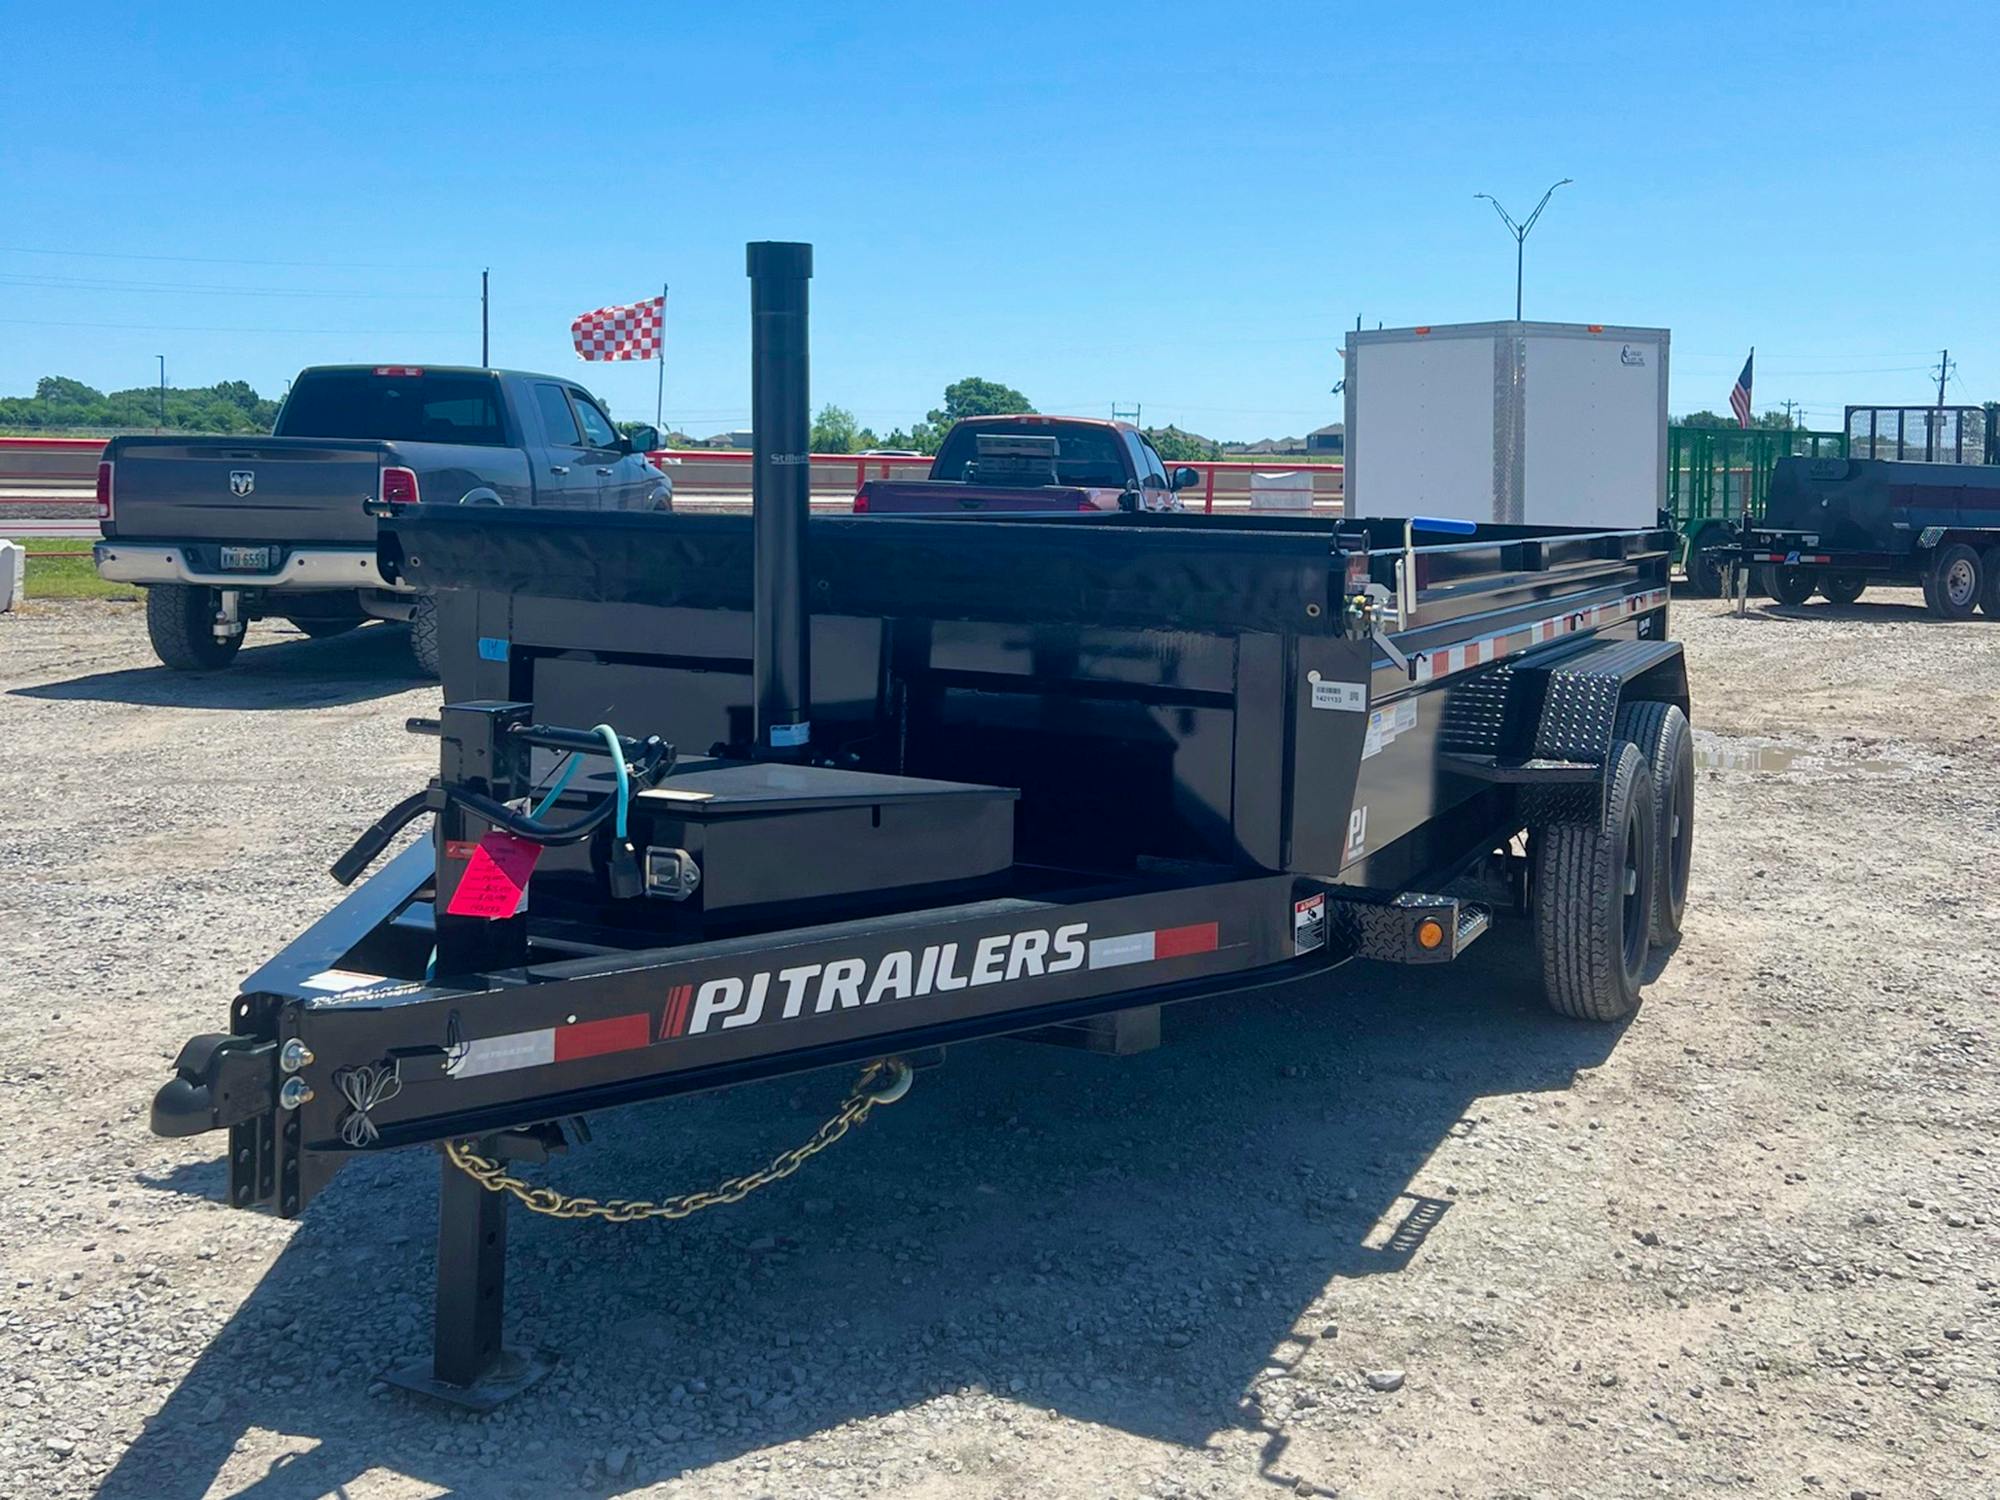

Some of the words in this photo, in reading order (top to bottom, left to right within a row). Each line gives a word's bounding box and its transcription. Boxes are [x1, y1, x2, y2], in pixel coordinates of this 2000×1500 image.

[1348, 806, 1367, 849] PJ
[688, 972, 771, 1035] PJ
[779, 922, 1089, 1019] TRAILERS
